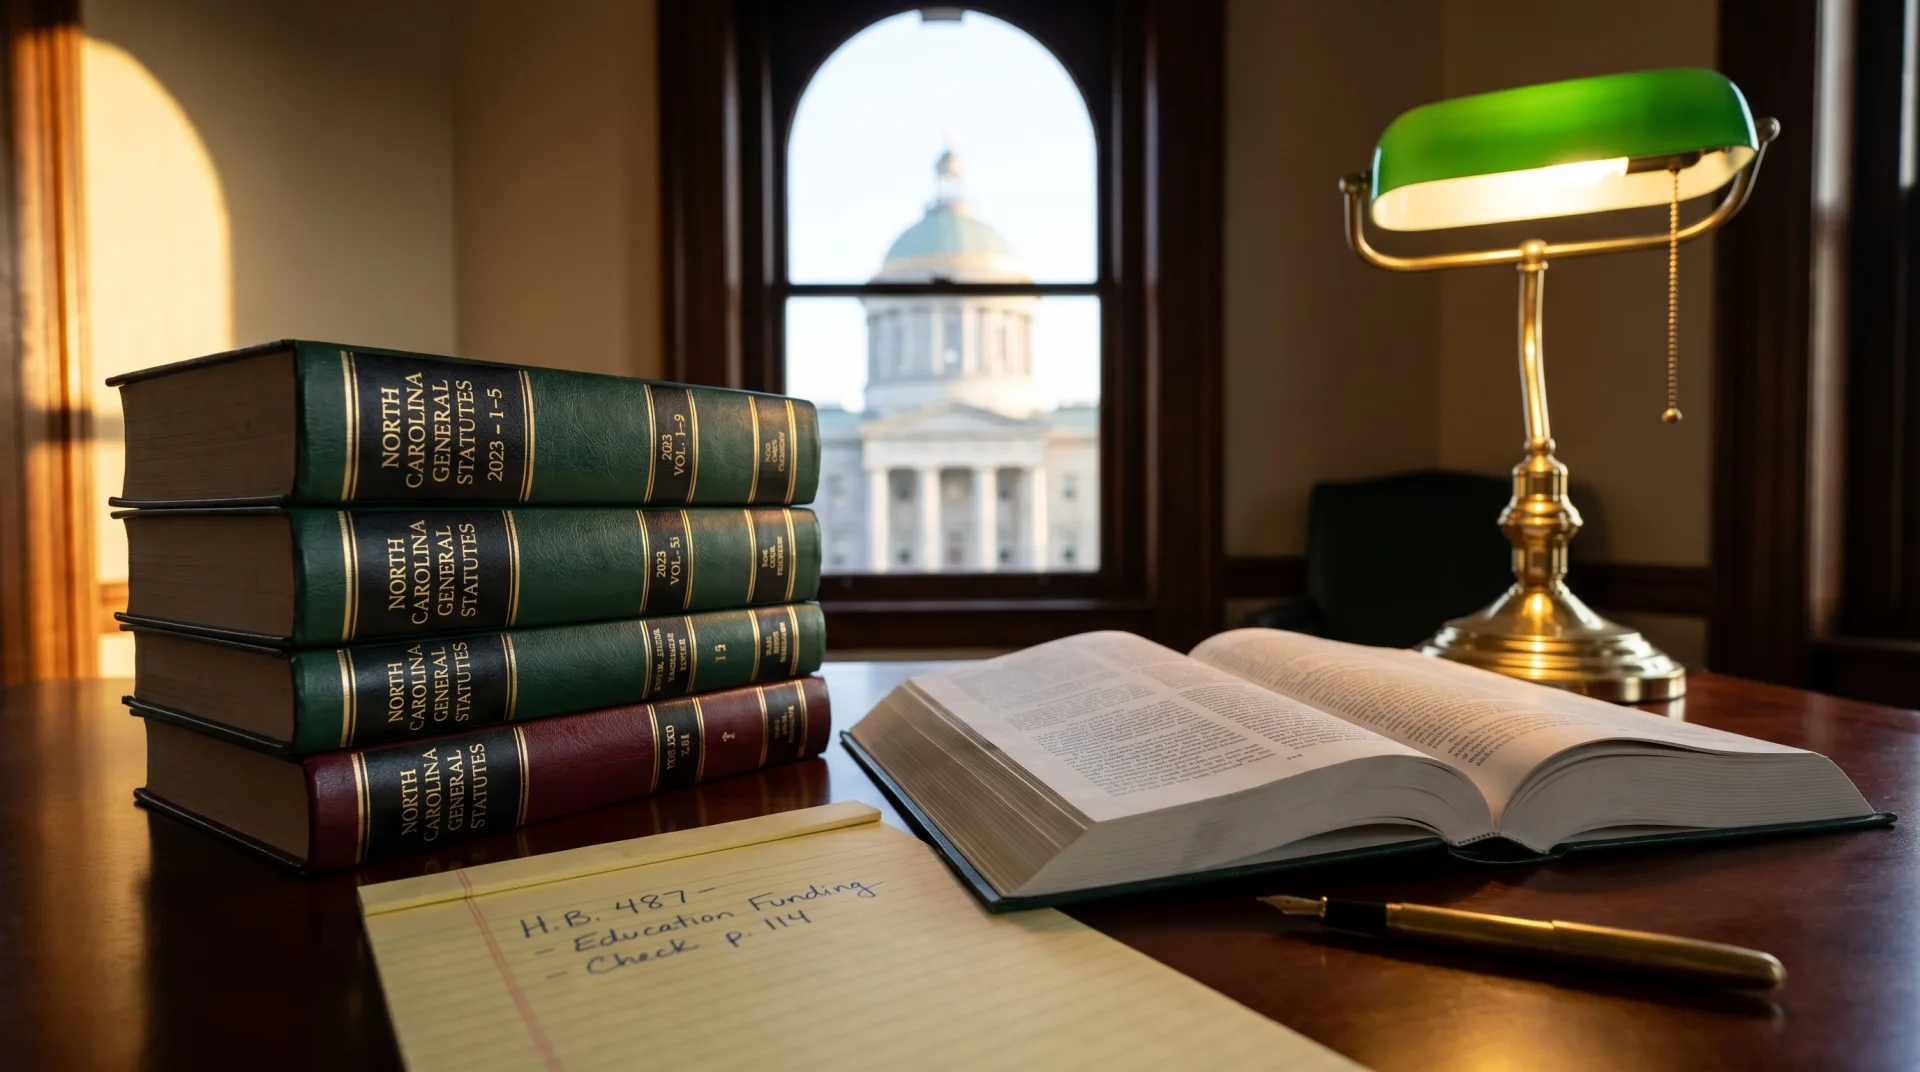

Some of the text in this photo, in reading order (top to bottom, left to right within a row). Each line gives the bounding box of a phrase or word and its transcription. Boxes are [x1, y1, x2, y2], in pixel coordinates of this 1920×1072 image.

[381, 387, 400, 468] NORTH
[405, 372, 426, 488] CAROLINA
[432, 379, 451, 483] GENERAL
[455, 380, 475, 485] STATUTES
[487, 441, 504, 482] 2023
[673, 442, 686, 477] VOL.
[387, 537, 406, 611] NORTH
[409, 519, 431, 625] CAROLINA
[435, 525, 454, 616] GENERAL
[458, 523, 479, 617] STATUTES
[656, 551, 667, 578] 2023
[387, 662, 405, 723] NORTH
[407, 644, 427, 731] CAROLINA
[431, 646, 449, 722] GENERAL
[452, 642, 471, 722] STATUTES
[400, 768, 419, 836] NORTH
[422, 747, 442, 842] CAROLINA
[447, 749, 465, 831] GENERAL
[469, 743, 488, 829] STATUTES
[574, 912, 734, 952] Education
[748, 881, 884, 911] Funding
[587, 939, 700, 974] Check
[764, 910, 812, 930] 114
[616, 890, 686, 914] 487
